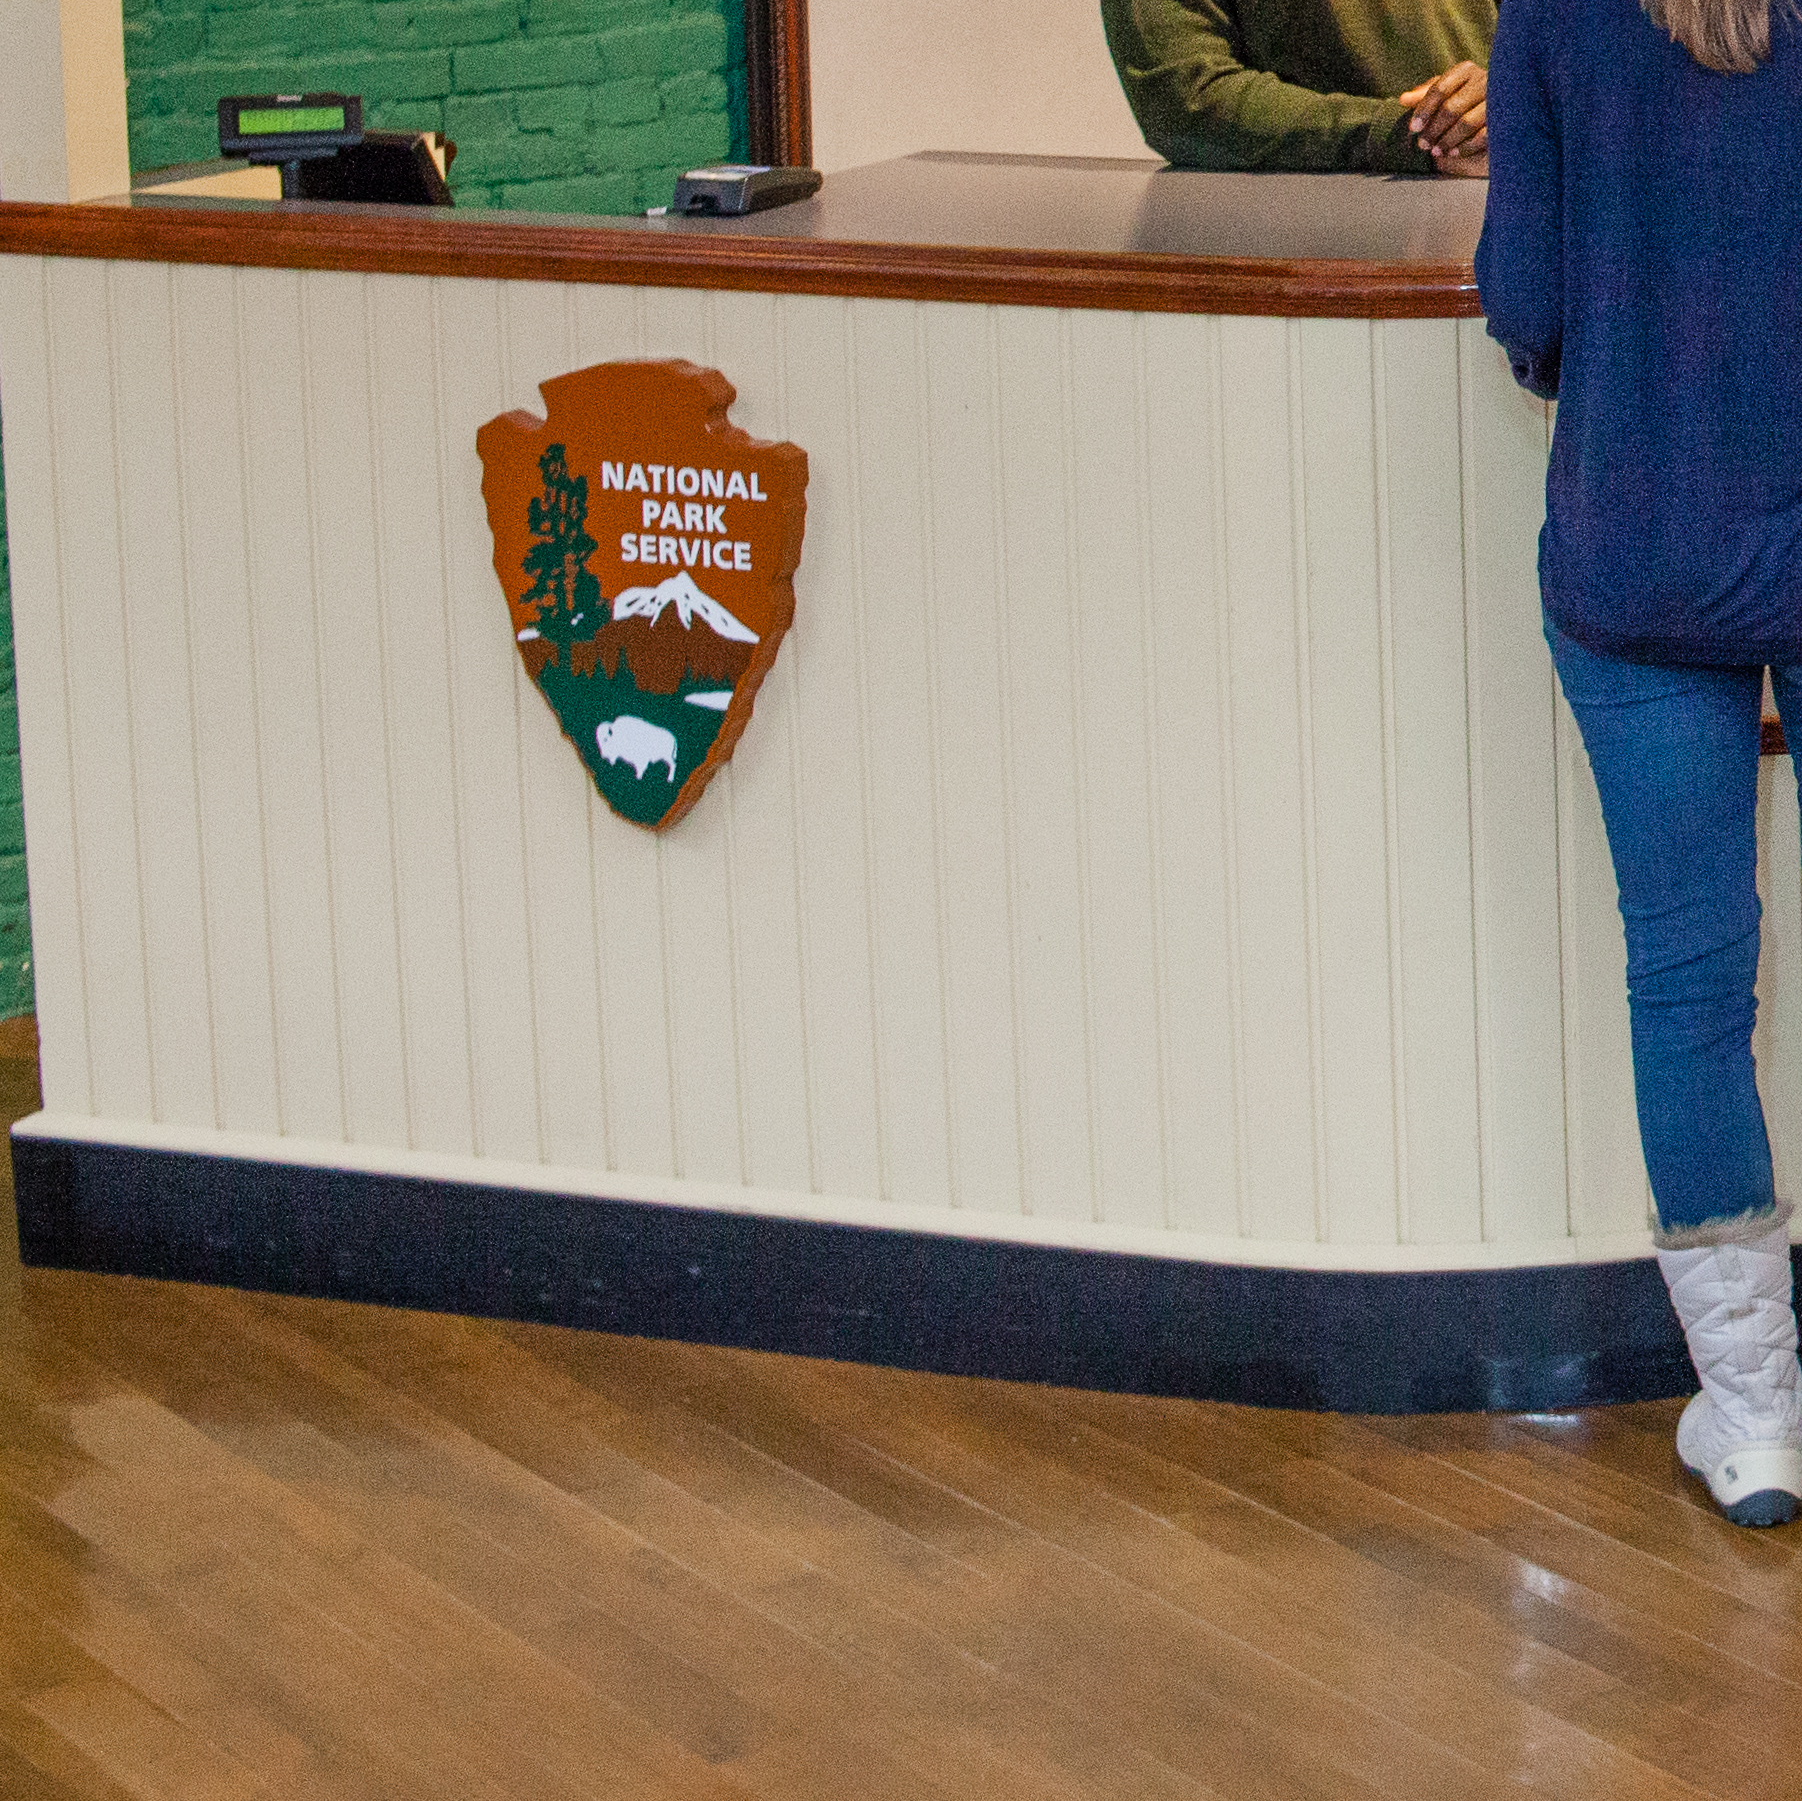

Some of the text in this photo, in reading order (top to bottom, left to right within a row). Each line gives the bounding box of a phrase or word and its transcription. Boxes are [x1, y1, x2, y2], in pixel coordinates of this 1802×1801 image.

[602, 461, 767, 502] NATIONAL
[642, 499, 727, 534] PARK
[620, 534, 753, 572] SERVICE
